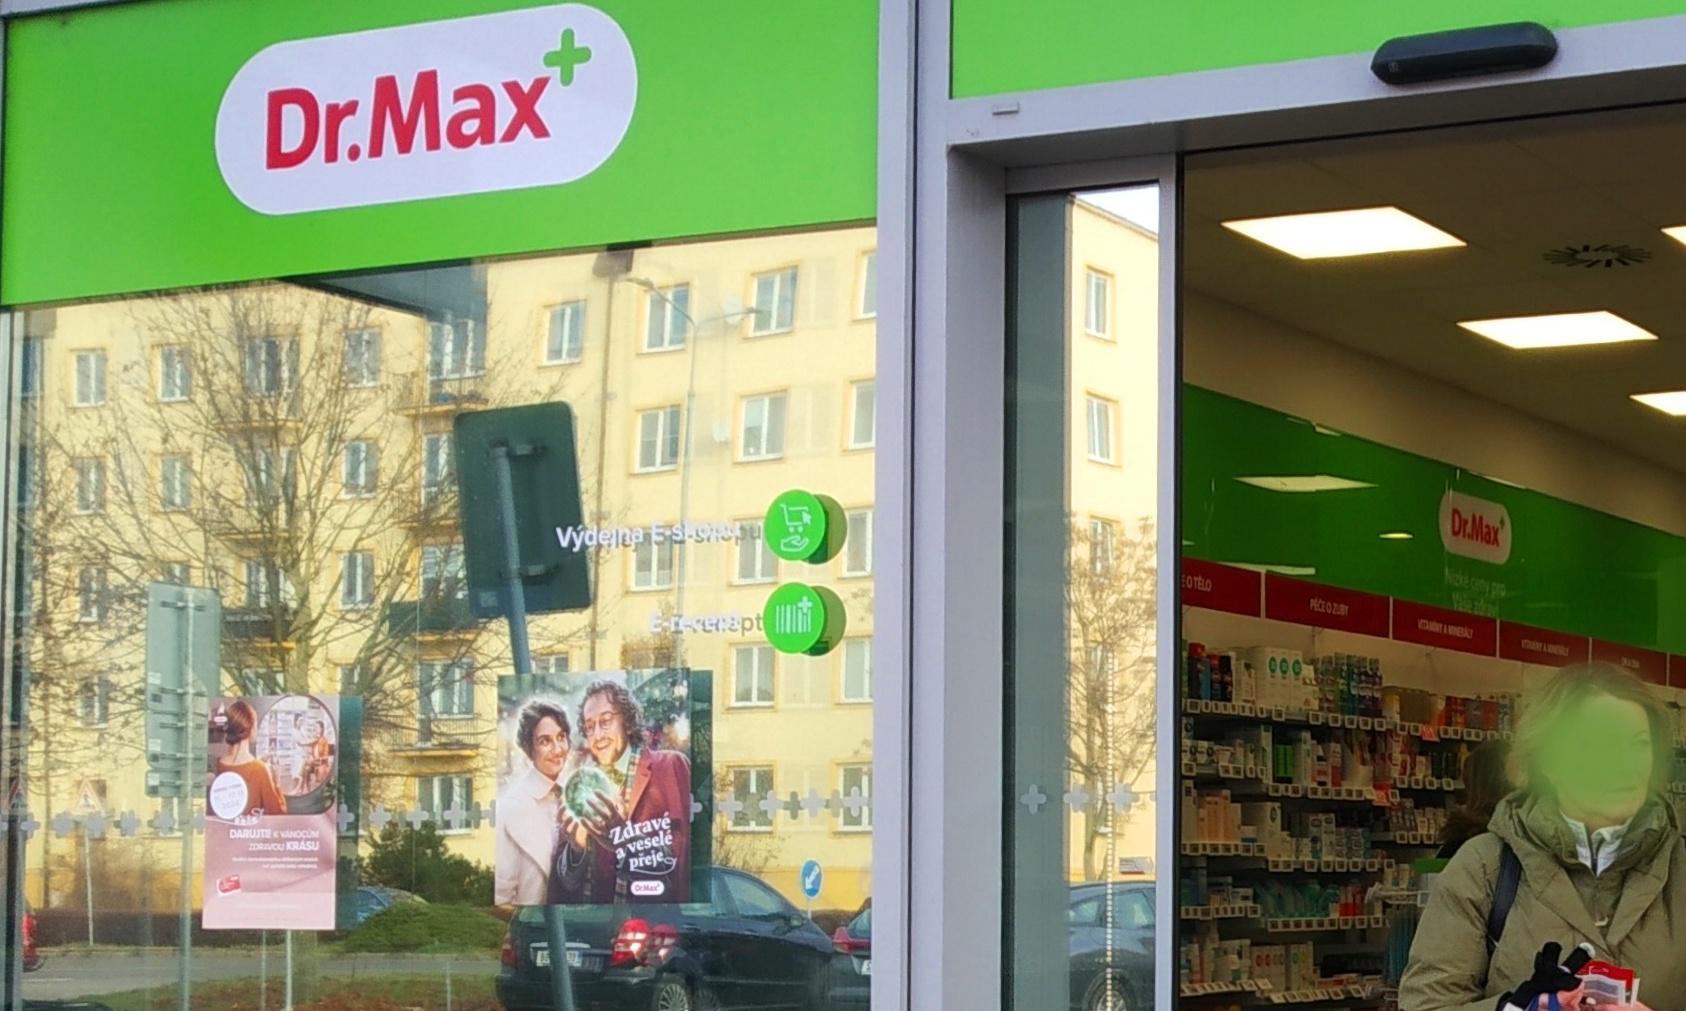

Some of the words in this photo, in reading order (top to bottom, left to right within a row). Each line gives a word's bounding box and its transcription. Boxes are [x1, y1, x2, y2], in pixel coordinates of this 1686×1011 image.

[266, 68, 550, 170] Dr.Max
[556, 524, 643, 552] Výdejna
[1452, 508, 1499, 547] Dr.Max
[608, 811, 671, 845] Zdravé
[626, 830, 672, 853] veselé
[629, 850, 666, 872] přeje
